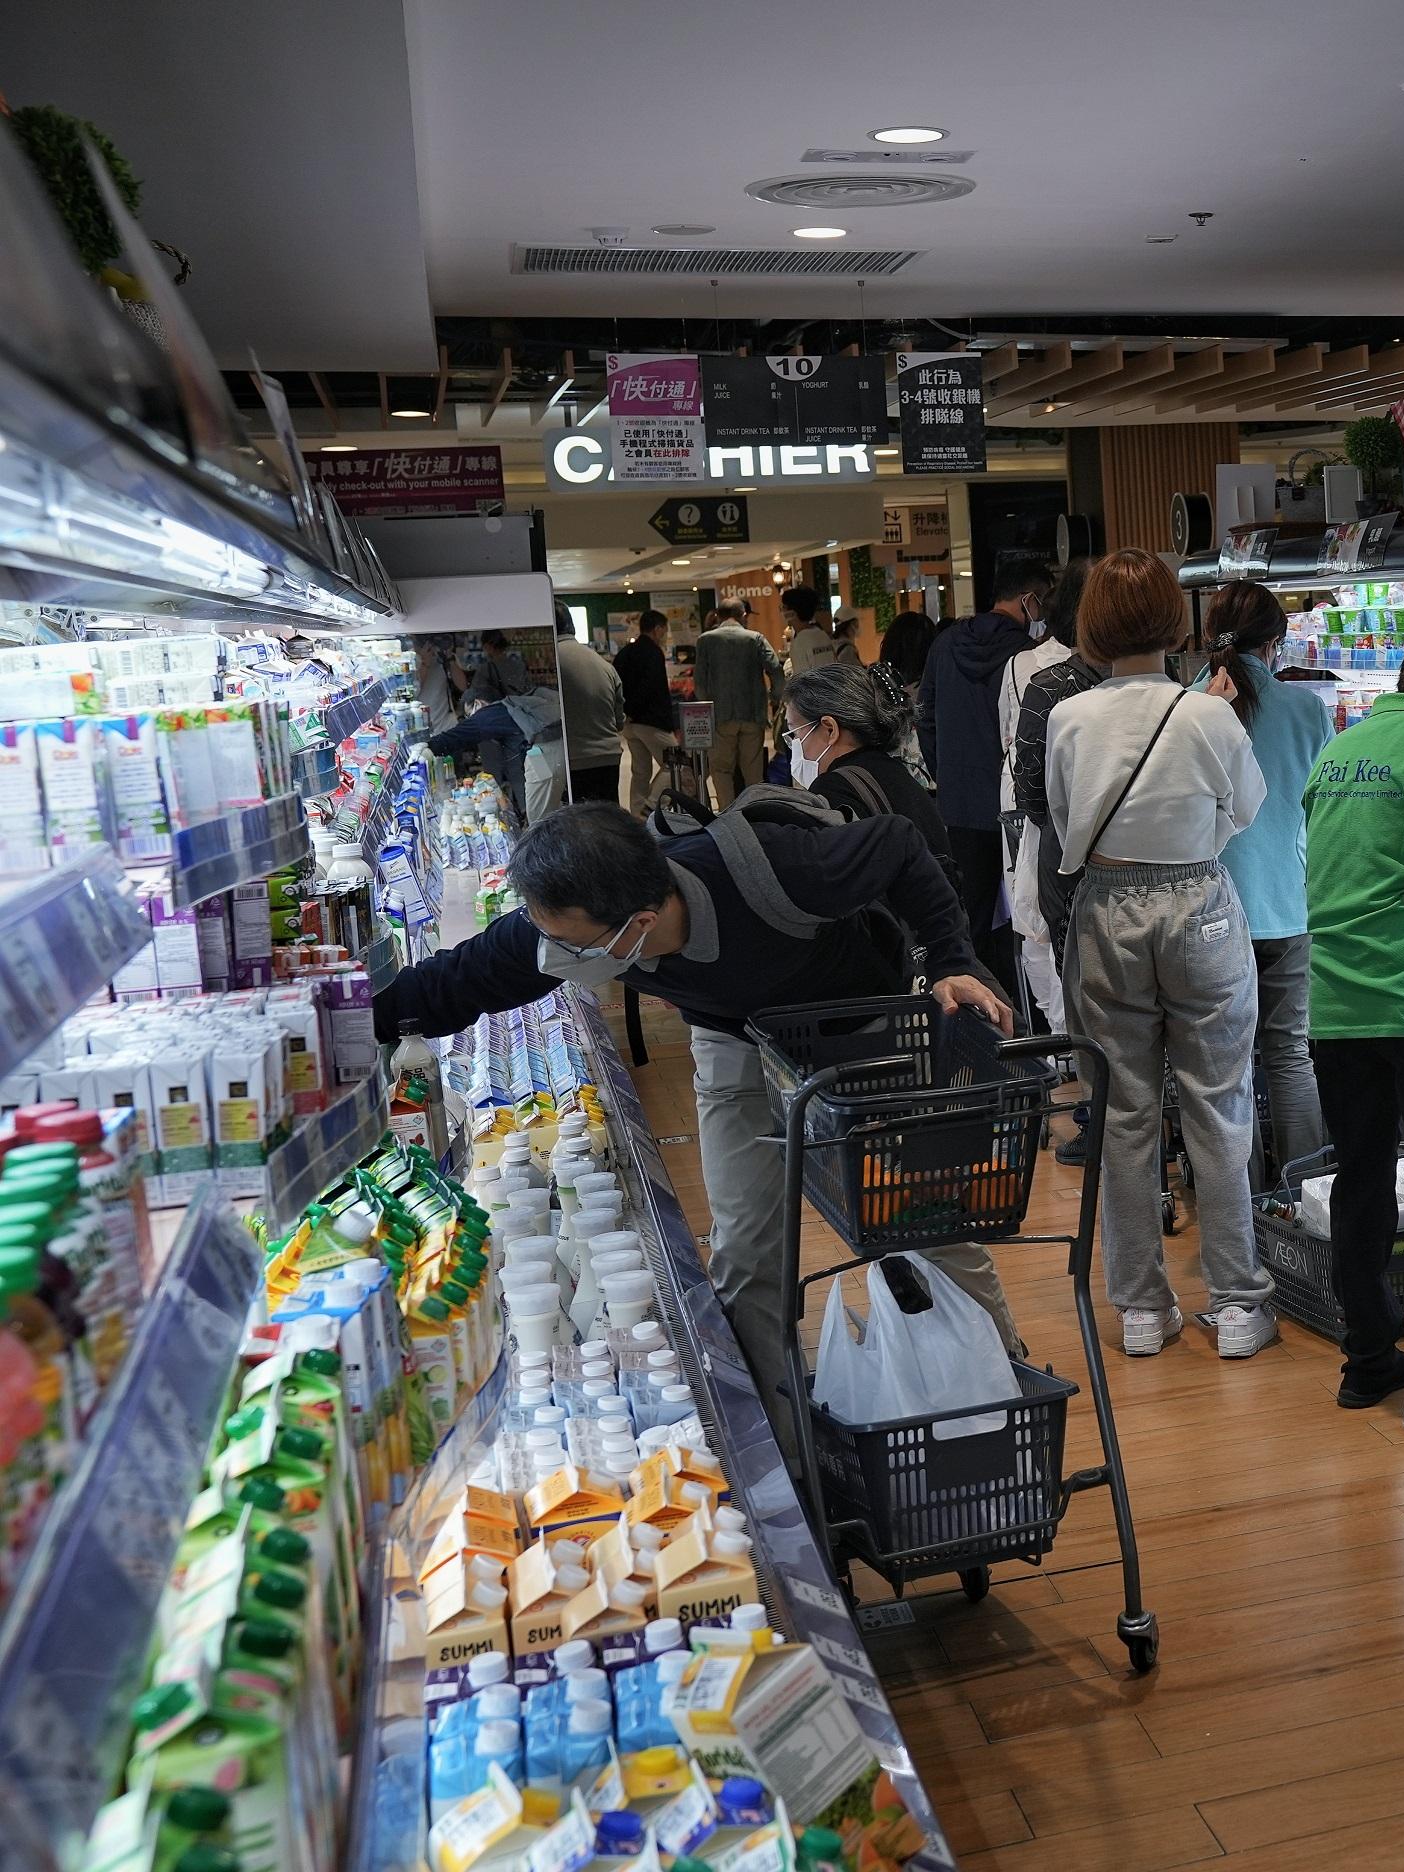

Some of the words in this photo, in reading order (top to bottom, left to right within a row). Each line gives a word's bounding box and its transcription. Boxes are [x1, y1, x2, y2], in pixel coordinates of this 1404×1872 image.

[775, 358, 814, 376] 10
[801, 381, 829, 389] YOGHURT
[918, 369, 962, 385] 此行為
[610, 376, 697, 401] 「快付通」
[713, 383, 727, 391] MILK
[900, 388, 981, 405] 3-4號收銀機
[920, 408, 964, 424] 排隊線
[759, 427, 770, 435] TEA
[553, 435, 870, 484] CHIER
[338, 481, 385, 492] check-out
[387, 480, 407, 489] with
[408, 480, 429, 491] your
[431, 478, 461, 487] mobile
[463, 477, 499, 486] scanner
[1315, 760, 1349, 783] Fai
[1352, 759, 1391, 783] Kee
[1327, 790, 1348, 798] Service
[1349, 790, 1375, 801] Company
[678, 1593, 742, 1623] SUMMI
[527, 1620, 562, 1644] SUM
[439, 1639, 494, 1661] SUMMI
